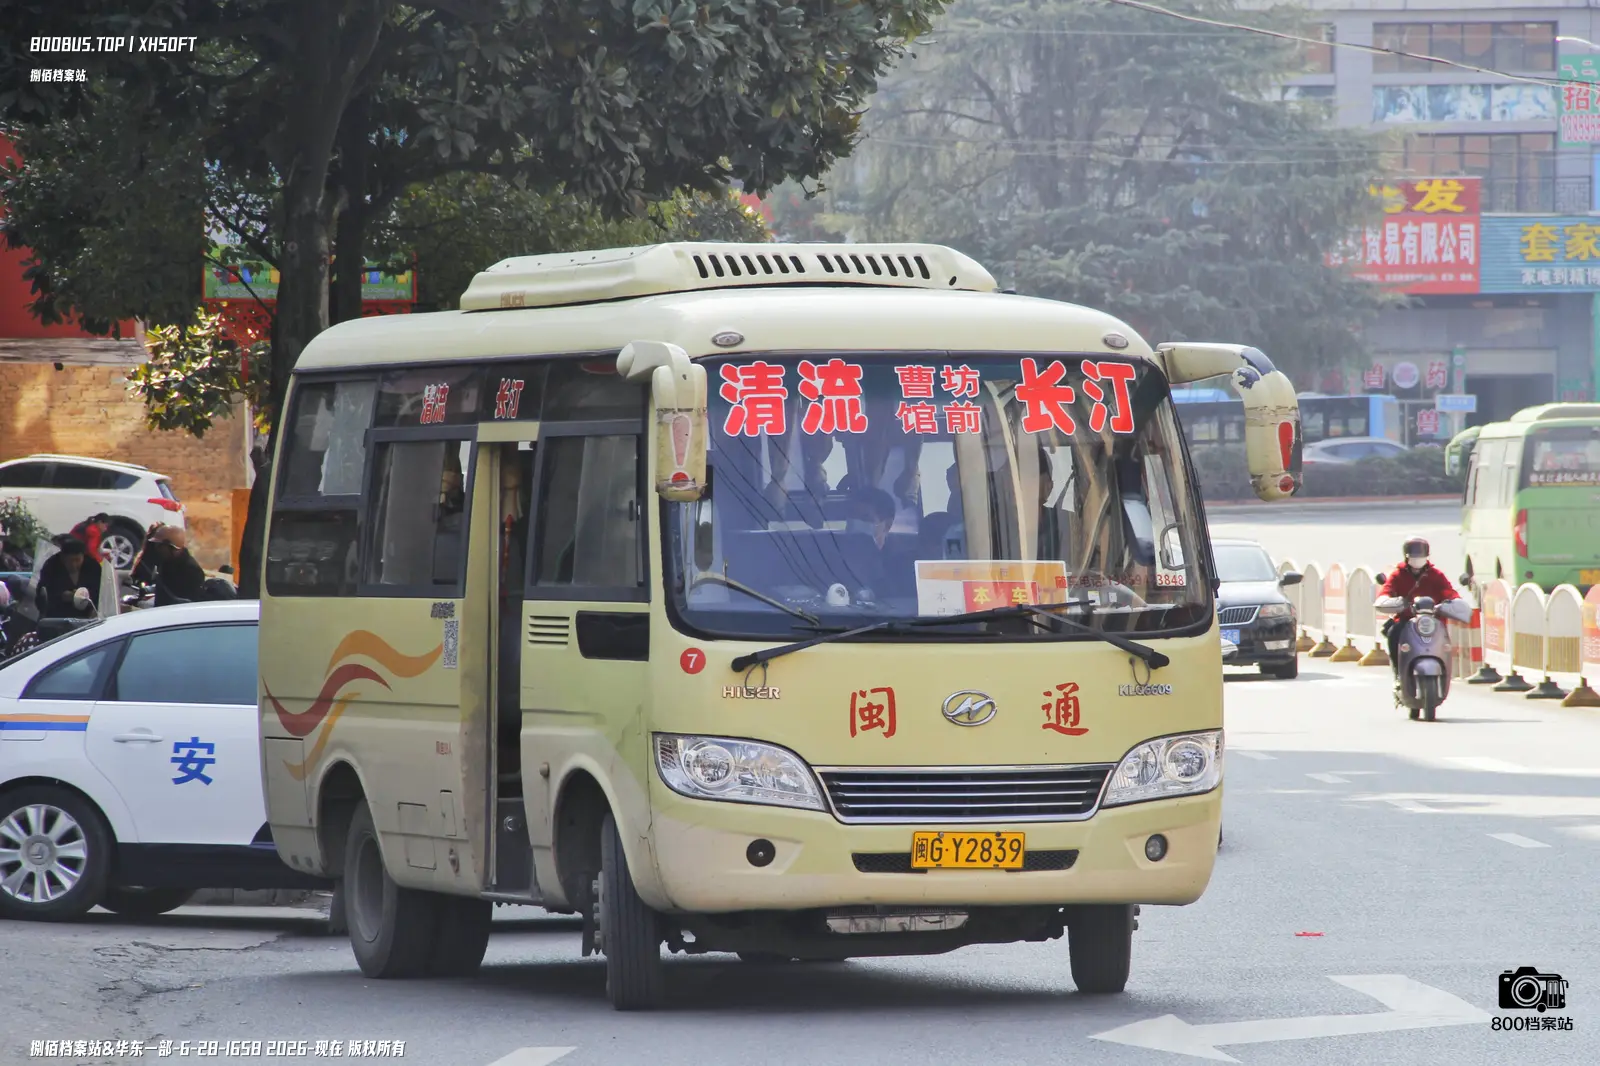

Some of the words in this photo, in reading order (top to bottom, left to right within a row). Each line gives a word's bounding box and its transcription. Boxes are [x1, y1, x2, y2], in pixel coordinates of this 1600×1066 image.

[495, 378, 524, 419] 长汀
[720, 358, 869, 437] 清流
[894, 364, 980, 398] 曹坊
[1015, 357, 1137, 436] 长汀
[420, 383, 449, 424] 清流
[895, 400, 982, 434] 馆前
[687, 653, 698, 668] 7
[722, 686, 781, 699] HIGER
[849, 685, 897, 738] 闽
[1042, 682, 1090, 736] 通
[170, 736, 216, 786] 安
